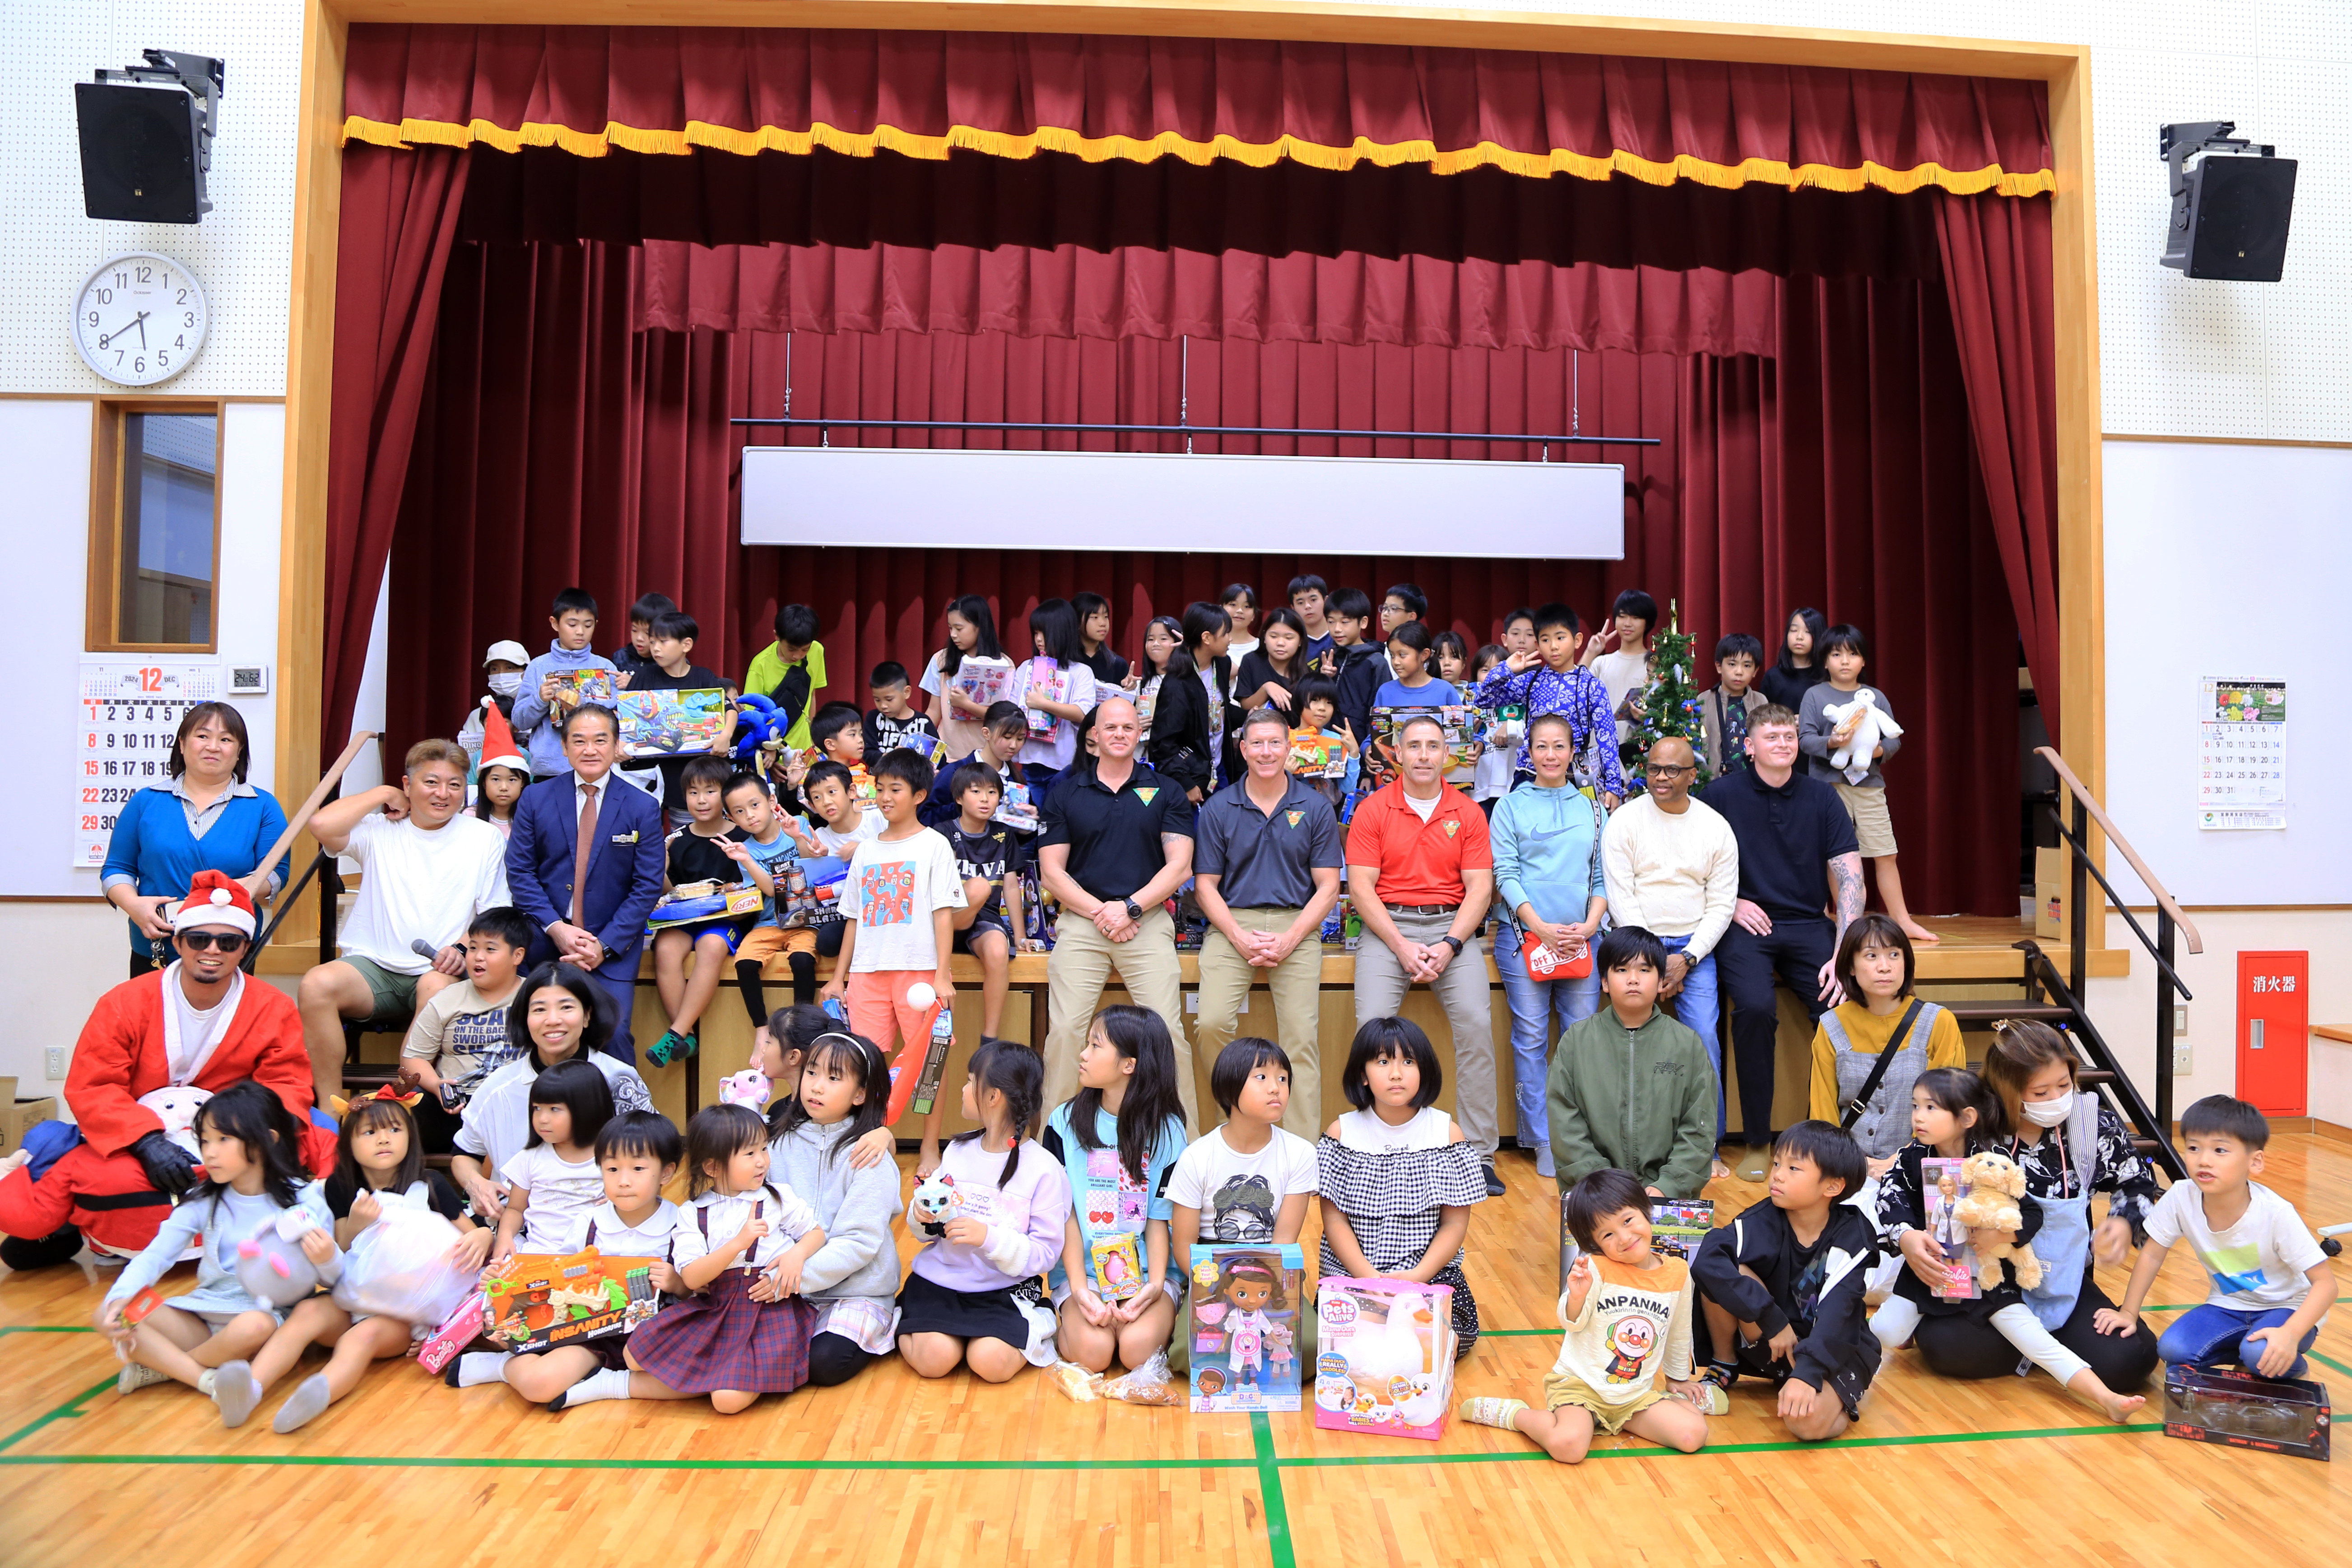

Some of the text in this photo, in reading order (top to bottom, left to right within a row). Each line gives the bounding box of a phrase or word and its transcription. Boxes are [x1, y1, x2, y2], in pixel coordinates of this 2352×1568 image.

[115, 273, 127, 289] 11
[135, 266, 152, 283] 12
[162, 273, 168, 289] 1
[96, 288, 112, 305] 10
[177, 288, 187, 305] 2
[89, 311, 99, 327] 9
[184, 312, 194, 328] 3
[99, 334, 109, 350] 8
[174, 334, 185, 350] 4
[115, 350, 124, 366] 7
[135, 357, 145, 372] 6
[158, 350, 168, 366] 5
[139, 667, 163, 692] 12
[249, 673, 260, 682] 62
[90, 706, 96, 721] 1
[107, 706, 116, 721] 2
[126, 706, 135, 721] 3
[145, 706, 153, 721] 4
[164, 706, 172, 721] 5
[88, 733, 96, 748] 8
[107, 733, 115, 748] 9
[122, 733, 136, 748] 10
[142, 733, 155, 748] 11
[160, 733, 174, 748] 12
[84, 761, 98, 776] 15
[103, 761, 117, 776] 16
[122, 761, 136, 776] 17
[141, 761, 155, 776] 18
[159, 761, 171, 776] 19
[82, 788, 99, 803] 22
[101, 788, 117, 803] 23
[81, 815, 98, 830] 29
[101, 815, 117, 830] 30
[731, 895, 760, 912] NERF
[809, 913, 848, 924] BLASTE
[814, 907, 838, 916] SHAR
[2252, 975, 2296, 993] 消火器
[1024, 1280, 1036, 1288] OVE
[1322, 1303, 1355, 1319] Pets
[1597, 1296, 1671, 1319] ANPANMA
[1328, 1313, 1354, 1323] Alive
[549, 1310, 623, 1343] INSANITY
[1341, 1325, 1356, 1333] Duck
[516, 1338, 548, 1354] XSHOT
[1391, 1386, 1410, 1394] GOLDEN
